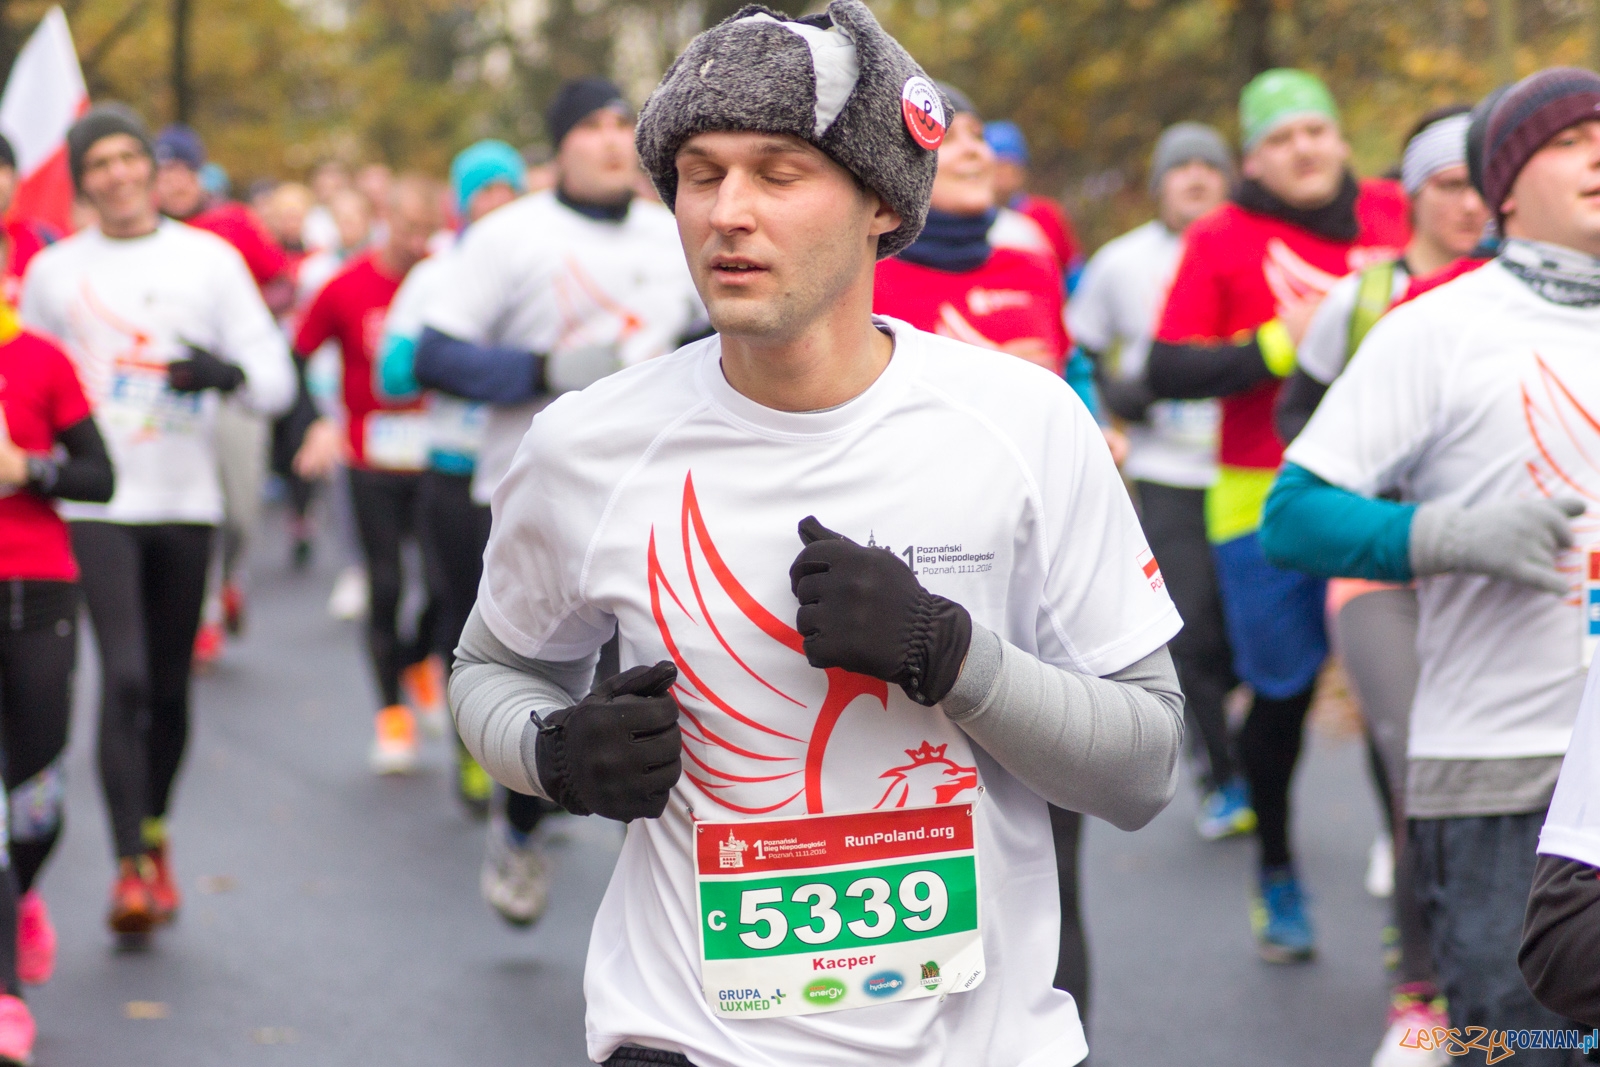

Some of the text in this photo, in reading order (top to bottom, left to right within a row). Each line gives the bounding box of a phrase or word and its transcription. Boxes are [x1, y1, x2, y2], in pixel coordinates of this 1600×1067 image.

[917, 544, 962, 554] Poznański
[902, 545, 918, 575] 1
[917, 555, 936, 563] Bieg
[764, 837, 797, 846] Poznański
[845, 826, 955, 848] RunPoland.org
[753, 839, 766, 860] 1
[779, 840, 826, 850] Niepodległości
[795, 848, 827, 857] 11.11.2016
[708, 870, 949, 950] C 5339
[812, 955, 876, 970] Kacper
[719, 988, 761, 1000] GRUPA
[809, 988, 843, 999] energy
[720, 1000, 770, 1012] LUXMED
